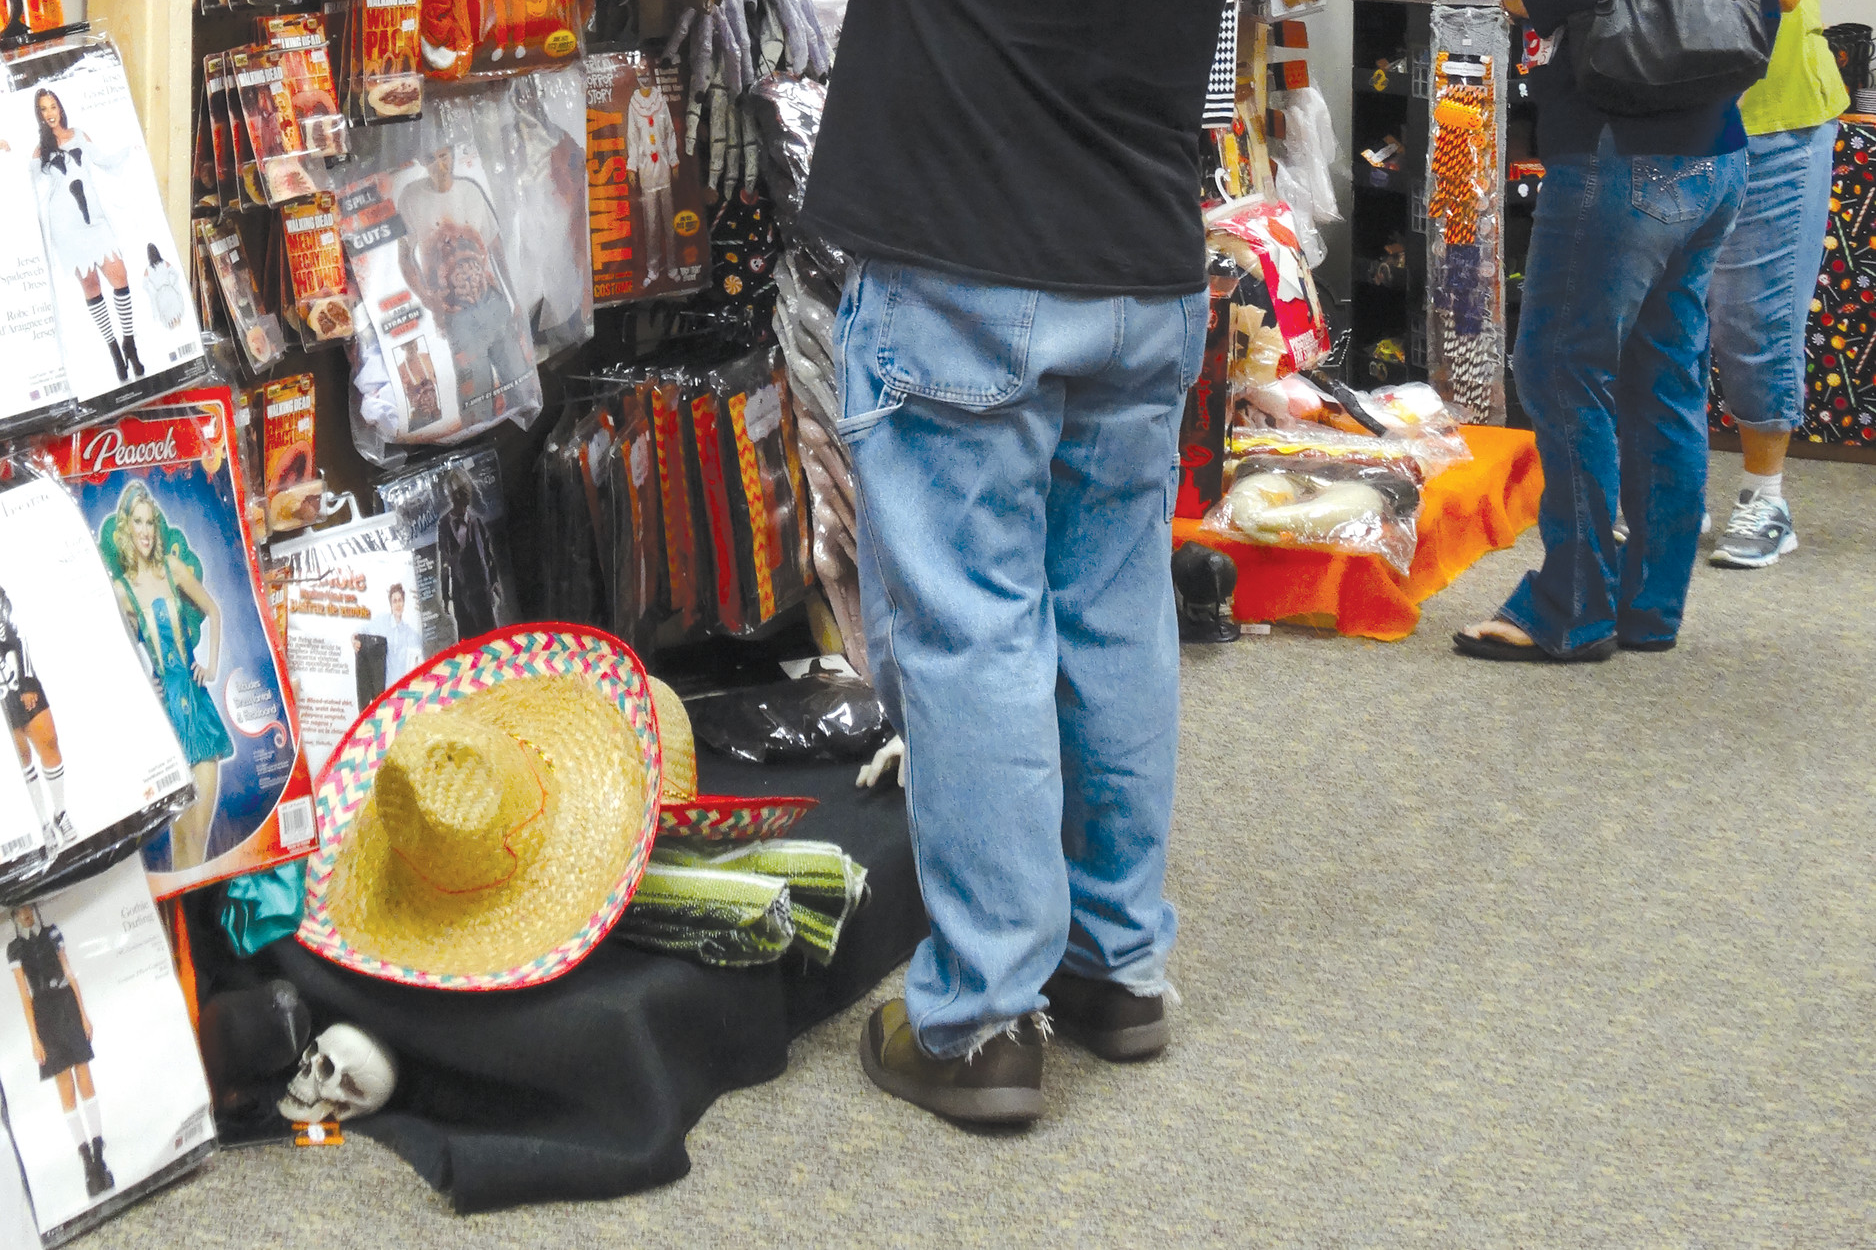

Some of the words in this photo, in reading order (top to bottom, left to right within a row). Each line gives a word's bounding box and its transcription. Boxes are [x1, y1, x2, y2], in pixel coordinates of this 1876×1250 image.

[238, 70, 265, 87] WALKING
[265, 66, 283, 82] DEAD
[586, 73, 614, 90] ORROR
[587, 89, 612, 104] STORY
[586, 108, 633, 271] TWISTY
[286, 216, 315, 233] WALKING
[315, 213, 333, 229] DEAD
[353, 224, 392, 250] GUTS
[291, 248, 339, 272] DECAYING
[294, 266, 344, 297] WOUND
[293, 395, 311, 412] DEAD
[82, 426, 177, 472] Peacock
